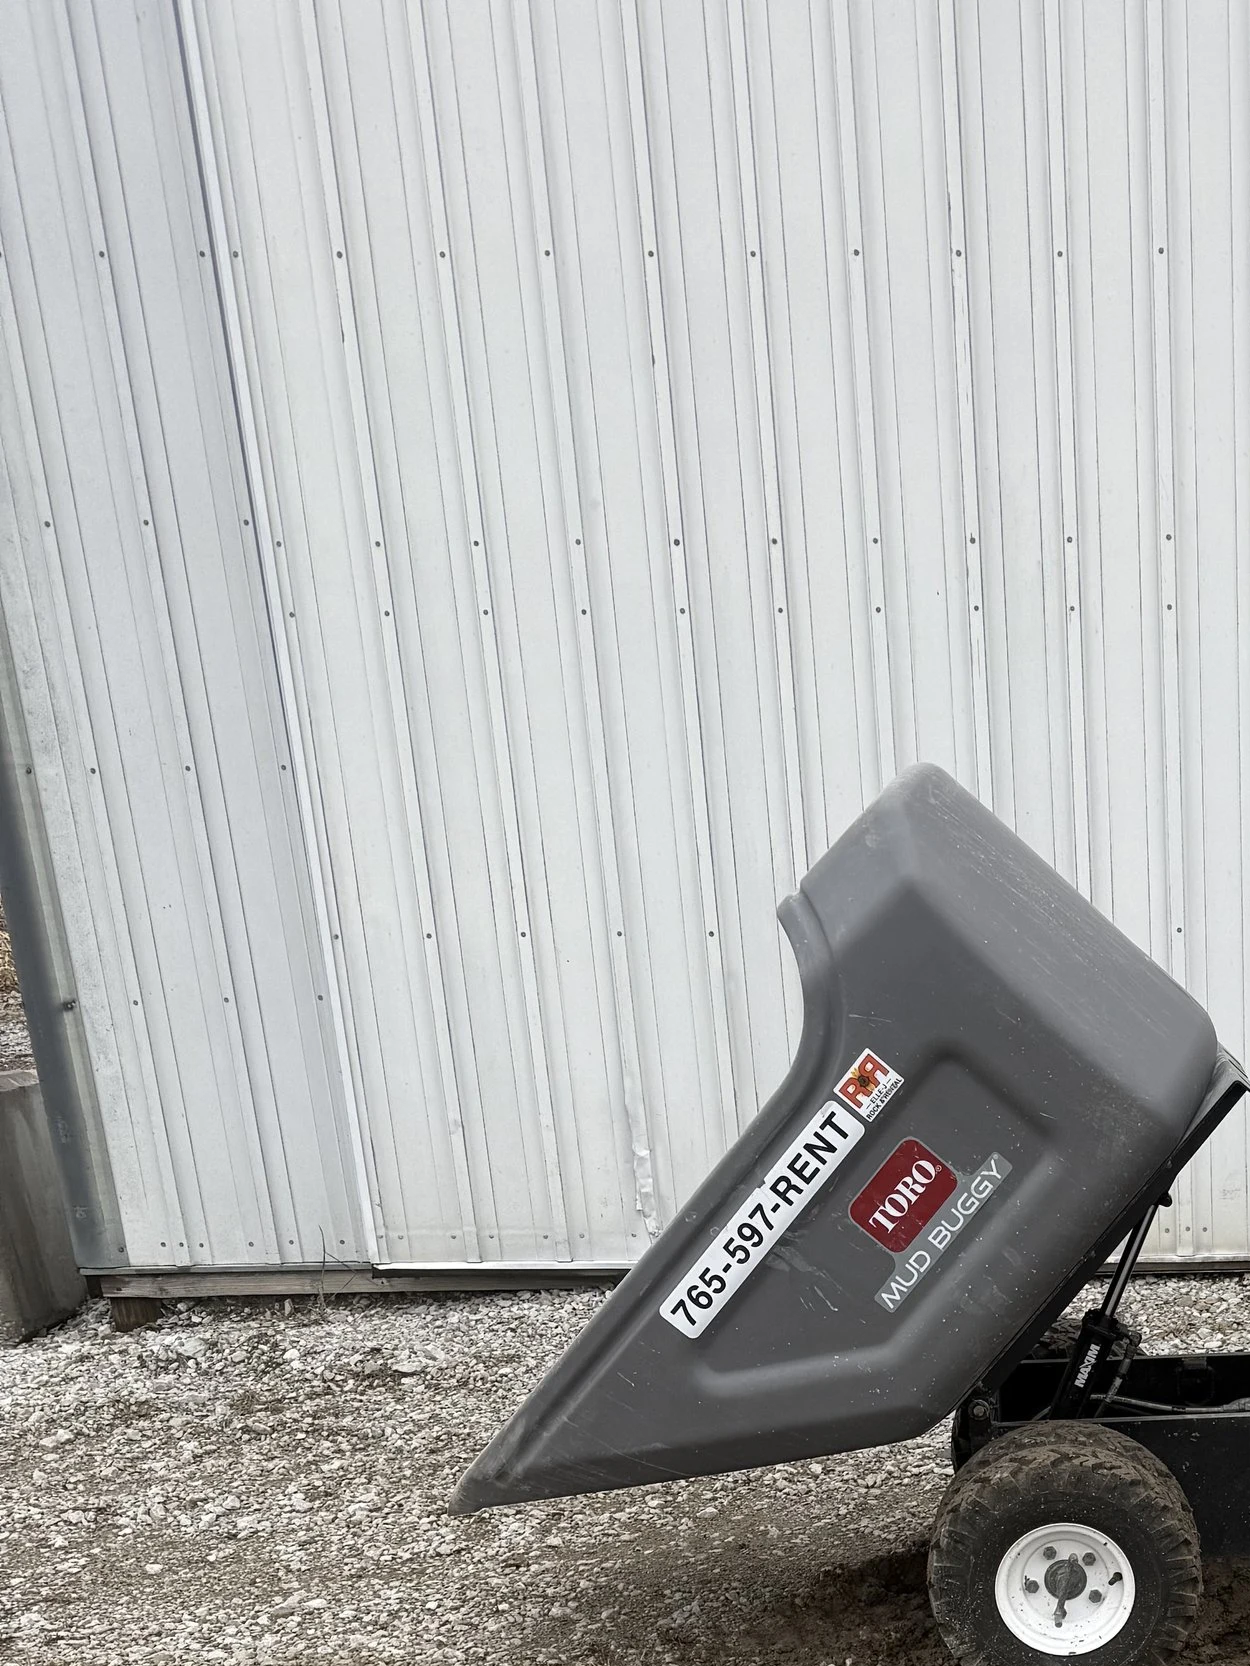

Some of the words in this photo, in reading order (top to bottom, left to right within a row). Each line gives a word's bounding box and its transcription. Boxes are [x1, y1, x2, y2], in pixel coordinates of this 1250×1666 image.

[866, 1102, 882, 1120] ROCK
[869, 1082, 888, 1104] ELLE-J
[670, 1110, 849, 1327] 765-597-RENT
[868, 1159, 937, 1234] TORO
[881, 1250, 931, 1309] MUD
[927, 1158, 1002, 1251] BUGGY
[1074, 1343, 1101, 1388] MAXIM
